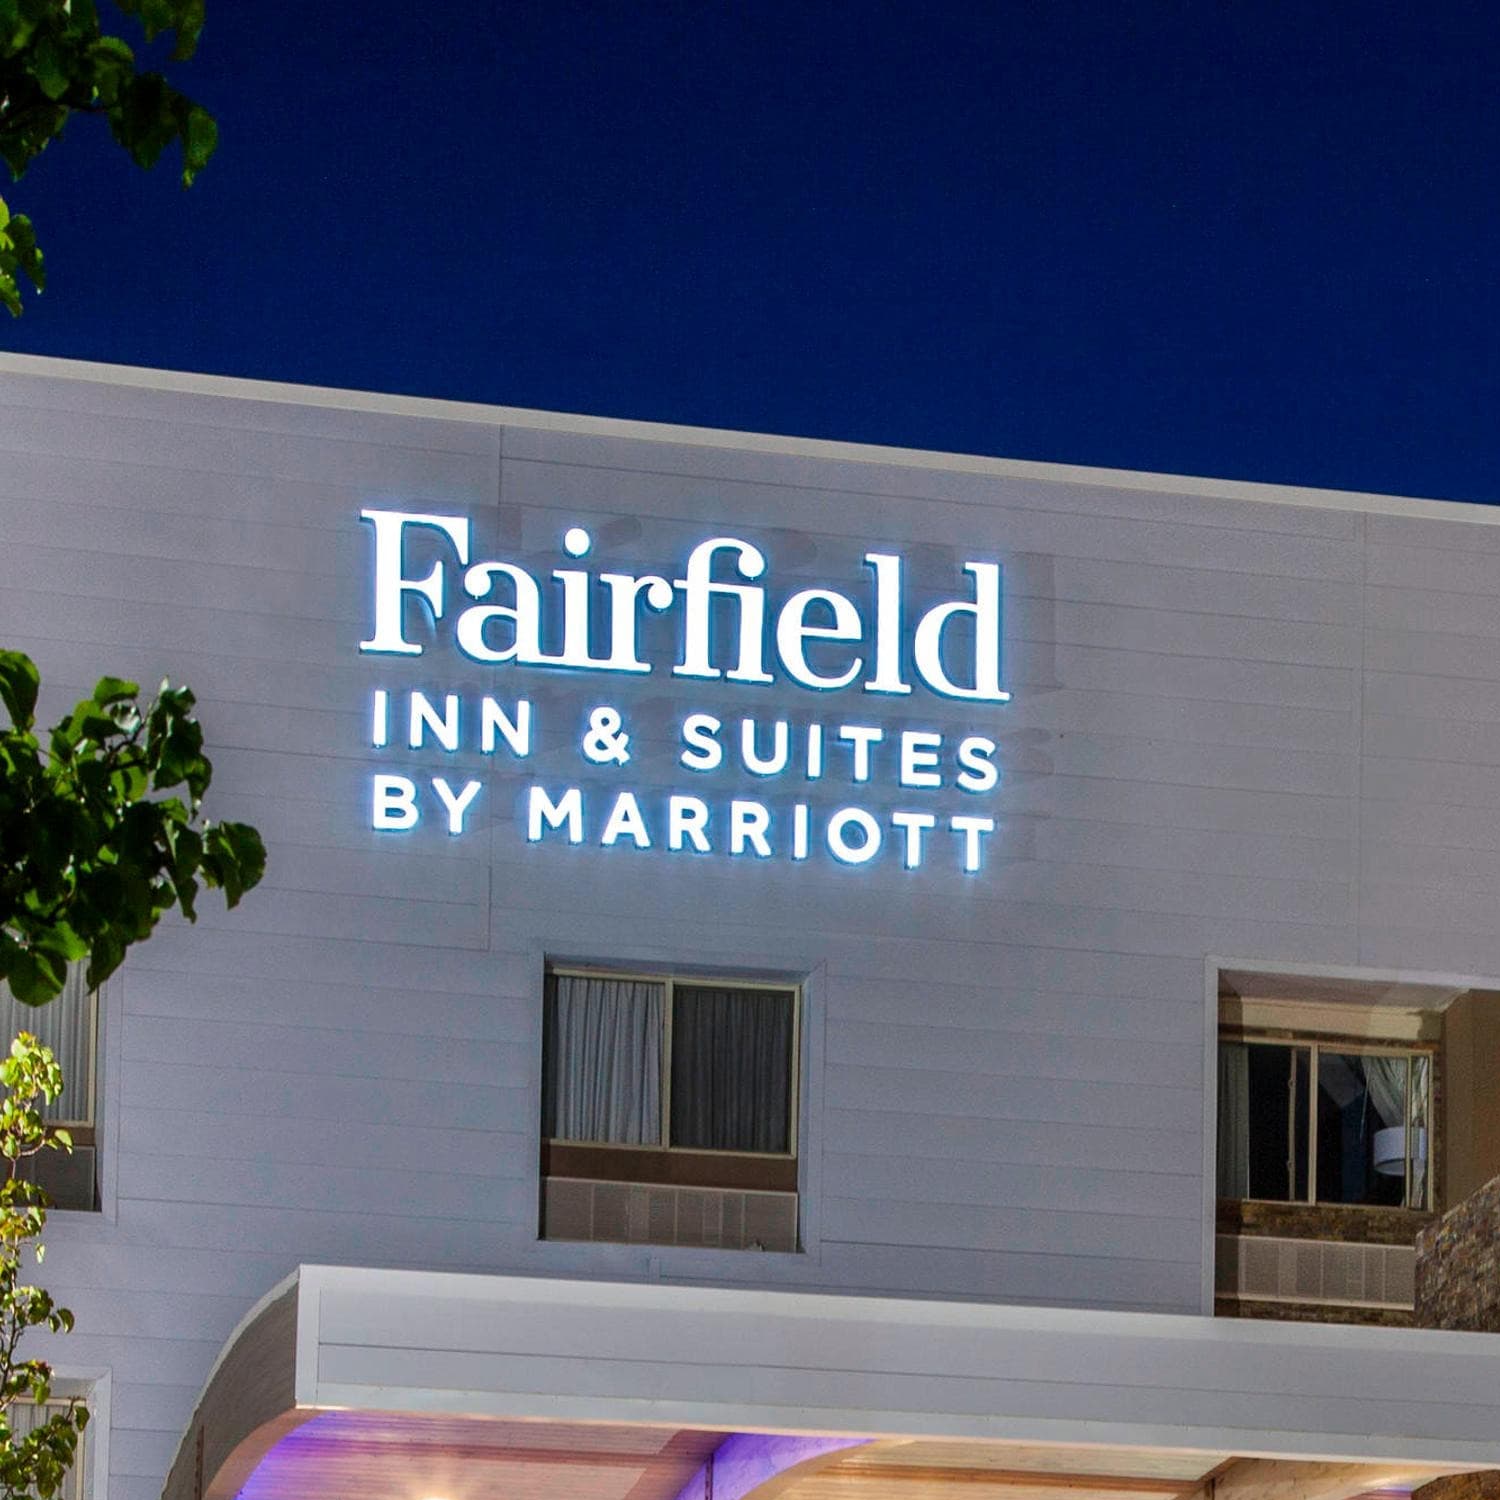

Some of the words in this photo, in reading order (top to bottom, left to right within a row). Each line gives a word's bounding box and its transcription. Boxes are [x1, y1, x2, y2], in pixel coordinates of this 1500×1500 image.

[359, 508, 1011, 702] Fairfield
[371, 689, 531, 758] INN
[582, 705, 631, 766] &
[680, 713, 999, 793] SUITES
[372, 774, 482, 836] BY
[527, 787, 996, 873] MARRIOTT
